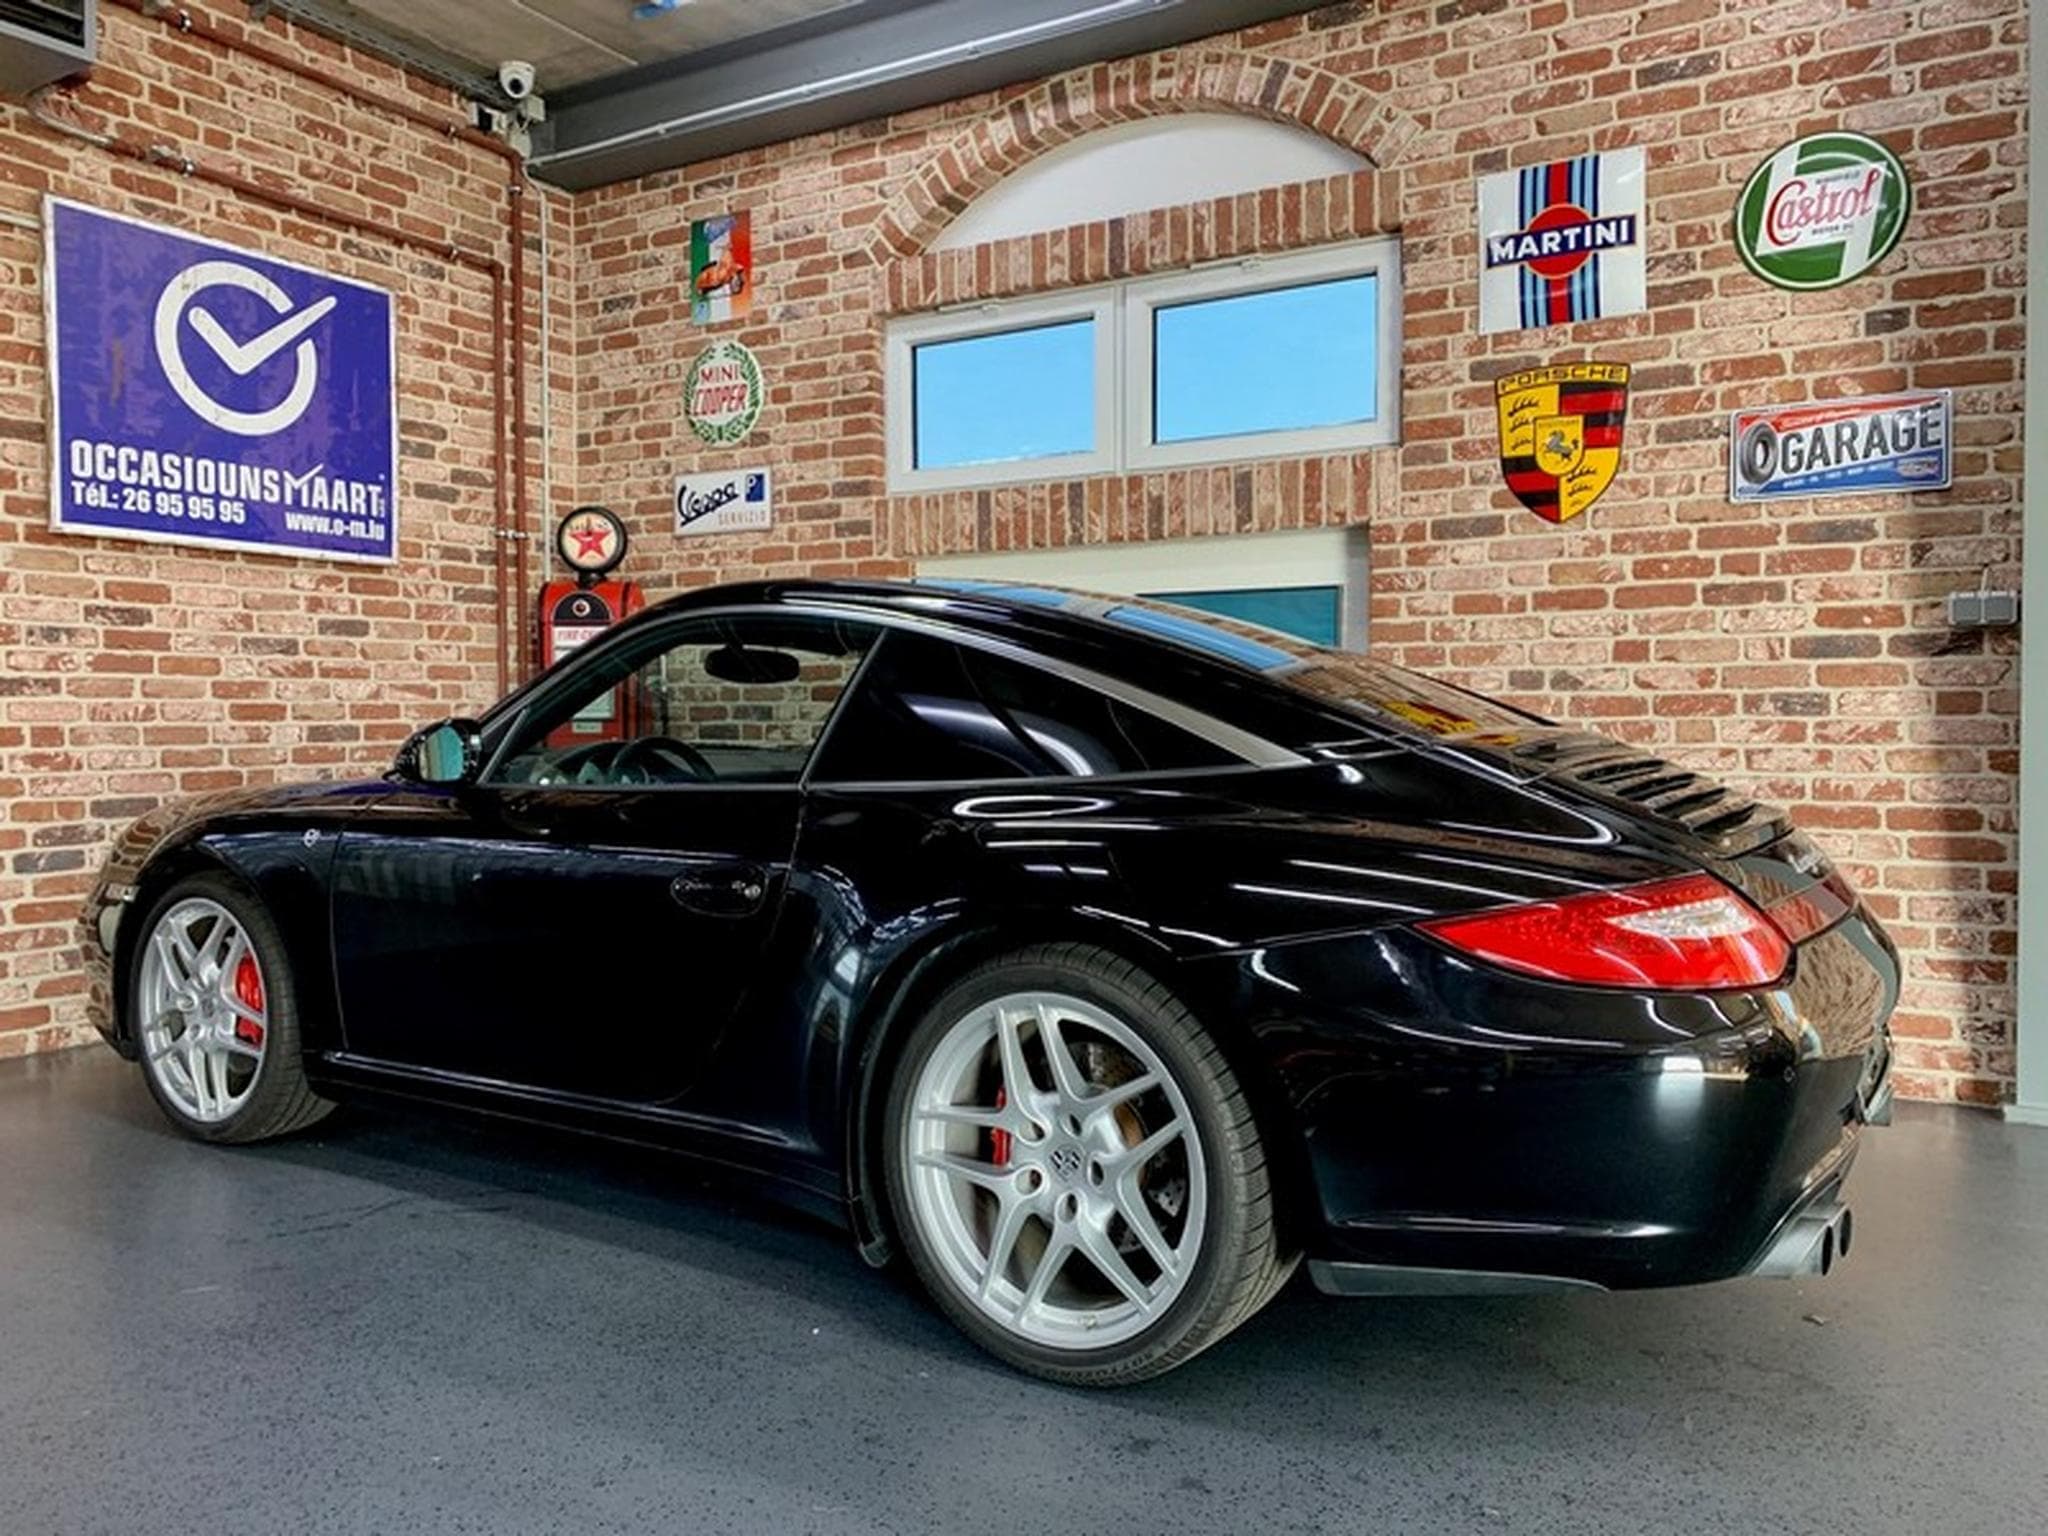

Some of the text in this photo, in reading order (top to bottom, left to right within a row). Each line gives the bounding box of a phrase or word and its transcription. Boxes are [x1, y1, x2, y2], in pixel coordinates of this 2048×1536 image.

[1765, 167, 1881, 247] Castrol
[1489, 218, 1630, 264] MARTINI
[700, 363, 739, 386] MINI
[1500, 365, 1624, 392] PORSCHE
[692, 382, 748, 416] COOPER
[1781, 402, 1943, 474] GARAGE
[122, 487, 152, 513] 26
[155, 491, 184, 517] 95
[188, 495, 216, 521] 95
[219, 500, 247, 524] 95
[677, 481, 740, 528] Vespa
[284, 511, 386, 541] www.o-m.lu
